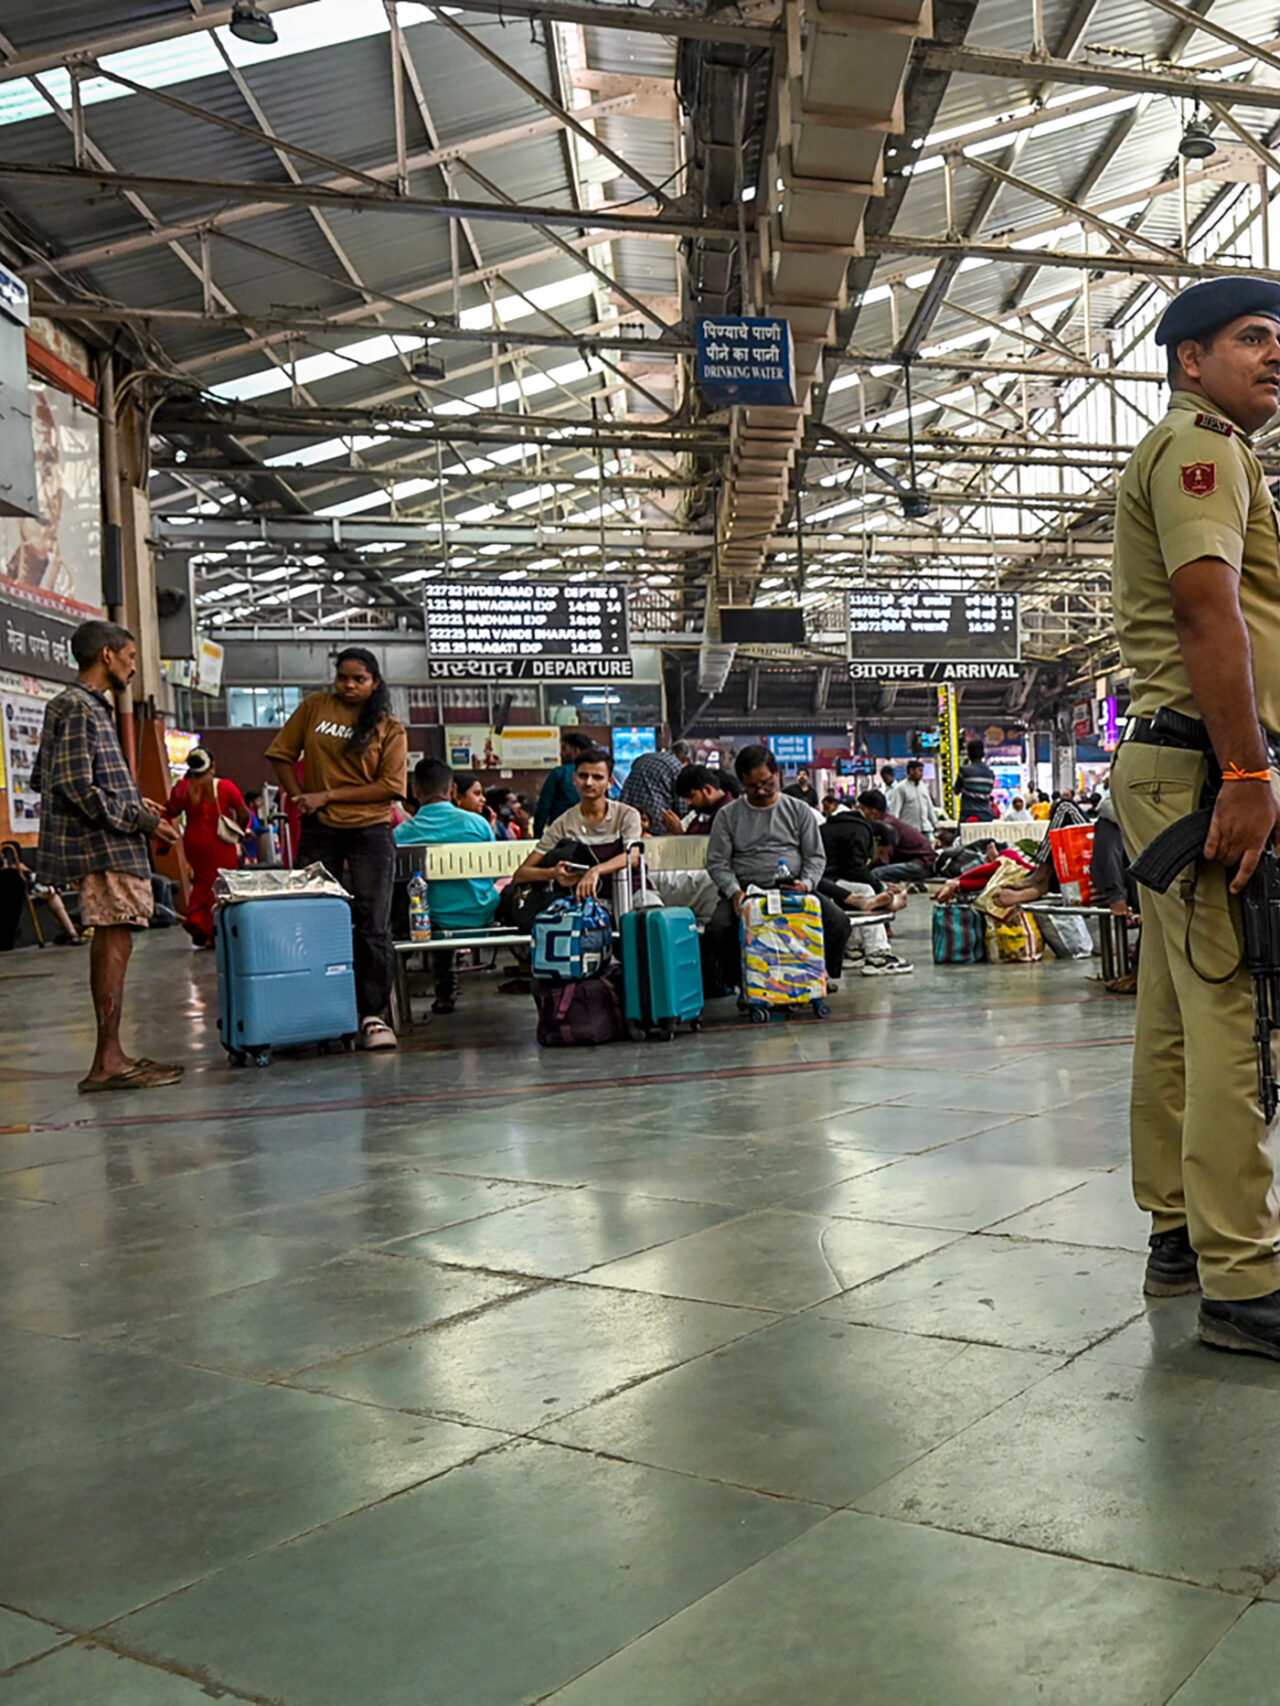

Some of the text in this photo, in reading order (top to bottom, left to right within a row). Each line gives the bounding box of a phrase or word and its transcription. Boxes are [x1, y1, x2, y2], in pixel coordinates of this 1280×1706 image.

[751, 323, 781, 340] पाणी
[706, 342, 779, 362] पीने का पानी
[704, 365, 784, 379] DRINKING WATER
[431, 661, 514, 677] प्रस्थान
[533, 661, 632, 676] DEPARTURE
[850, 664, 925, 679] आगमन
[944, 664, 1019, 678] ARRIVAL
